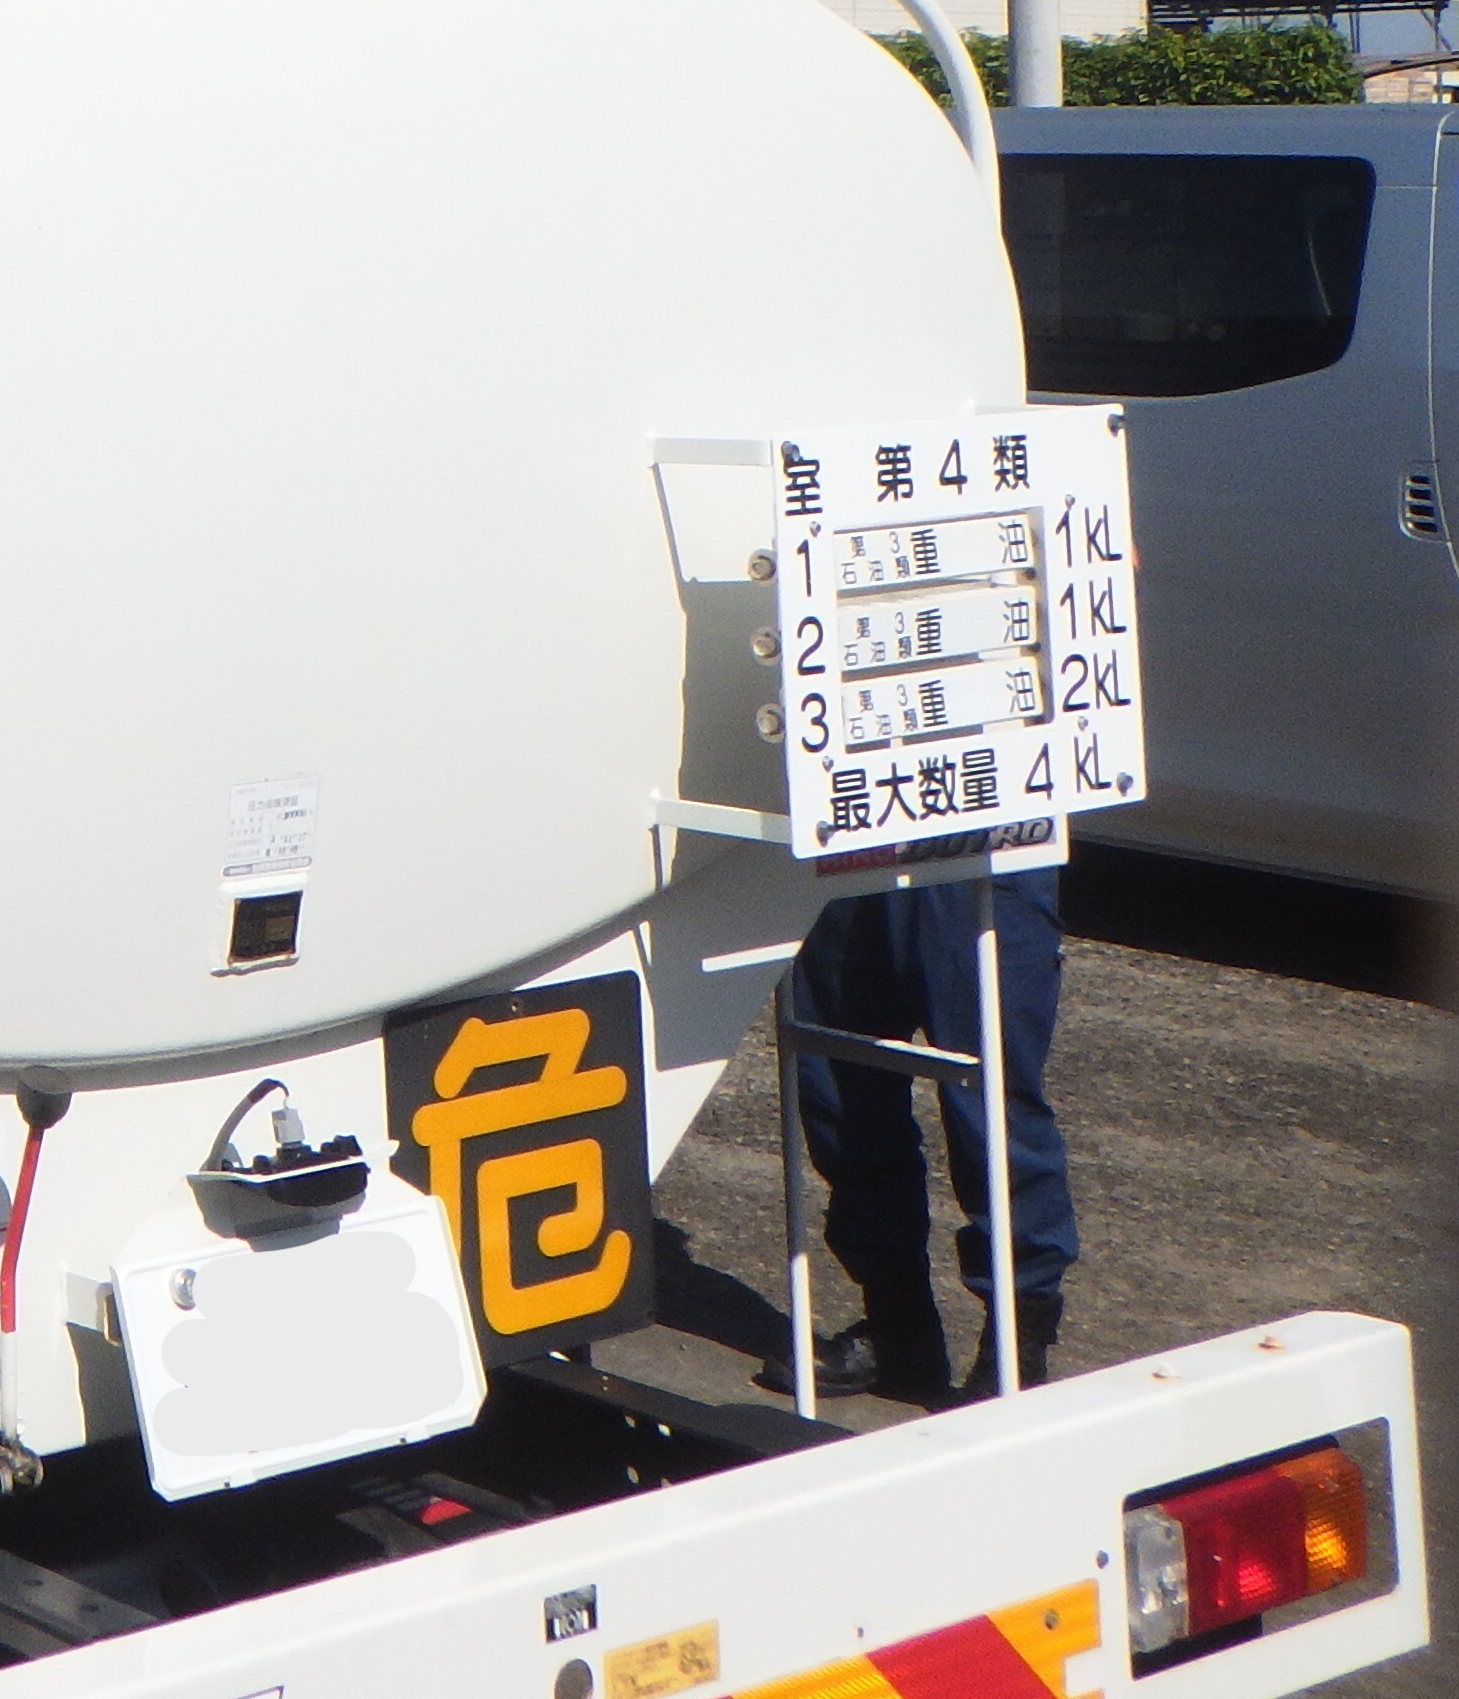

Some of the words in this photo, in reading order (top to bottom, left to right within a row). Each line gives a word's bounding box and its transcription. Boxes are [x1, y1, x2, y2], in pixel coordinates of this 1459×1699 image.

[876, 434, 1030, 502] 第4類
[797, 539, 812, 597] 1
[797, 616, 826, 676] 2
[801, 693, 830, 752] 3
[830, 748, 1000, 832] 最大数量
[412, 1008, 631, 1335] 危
